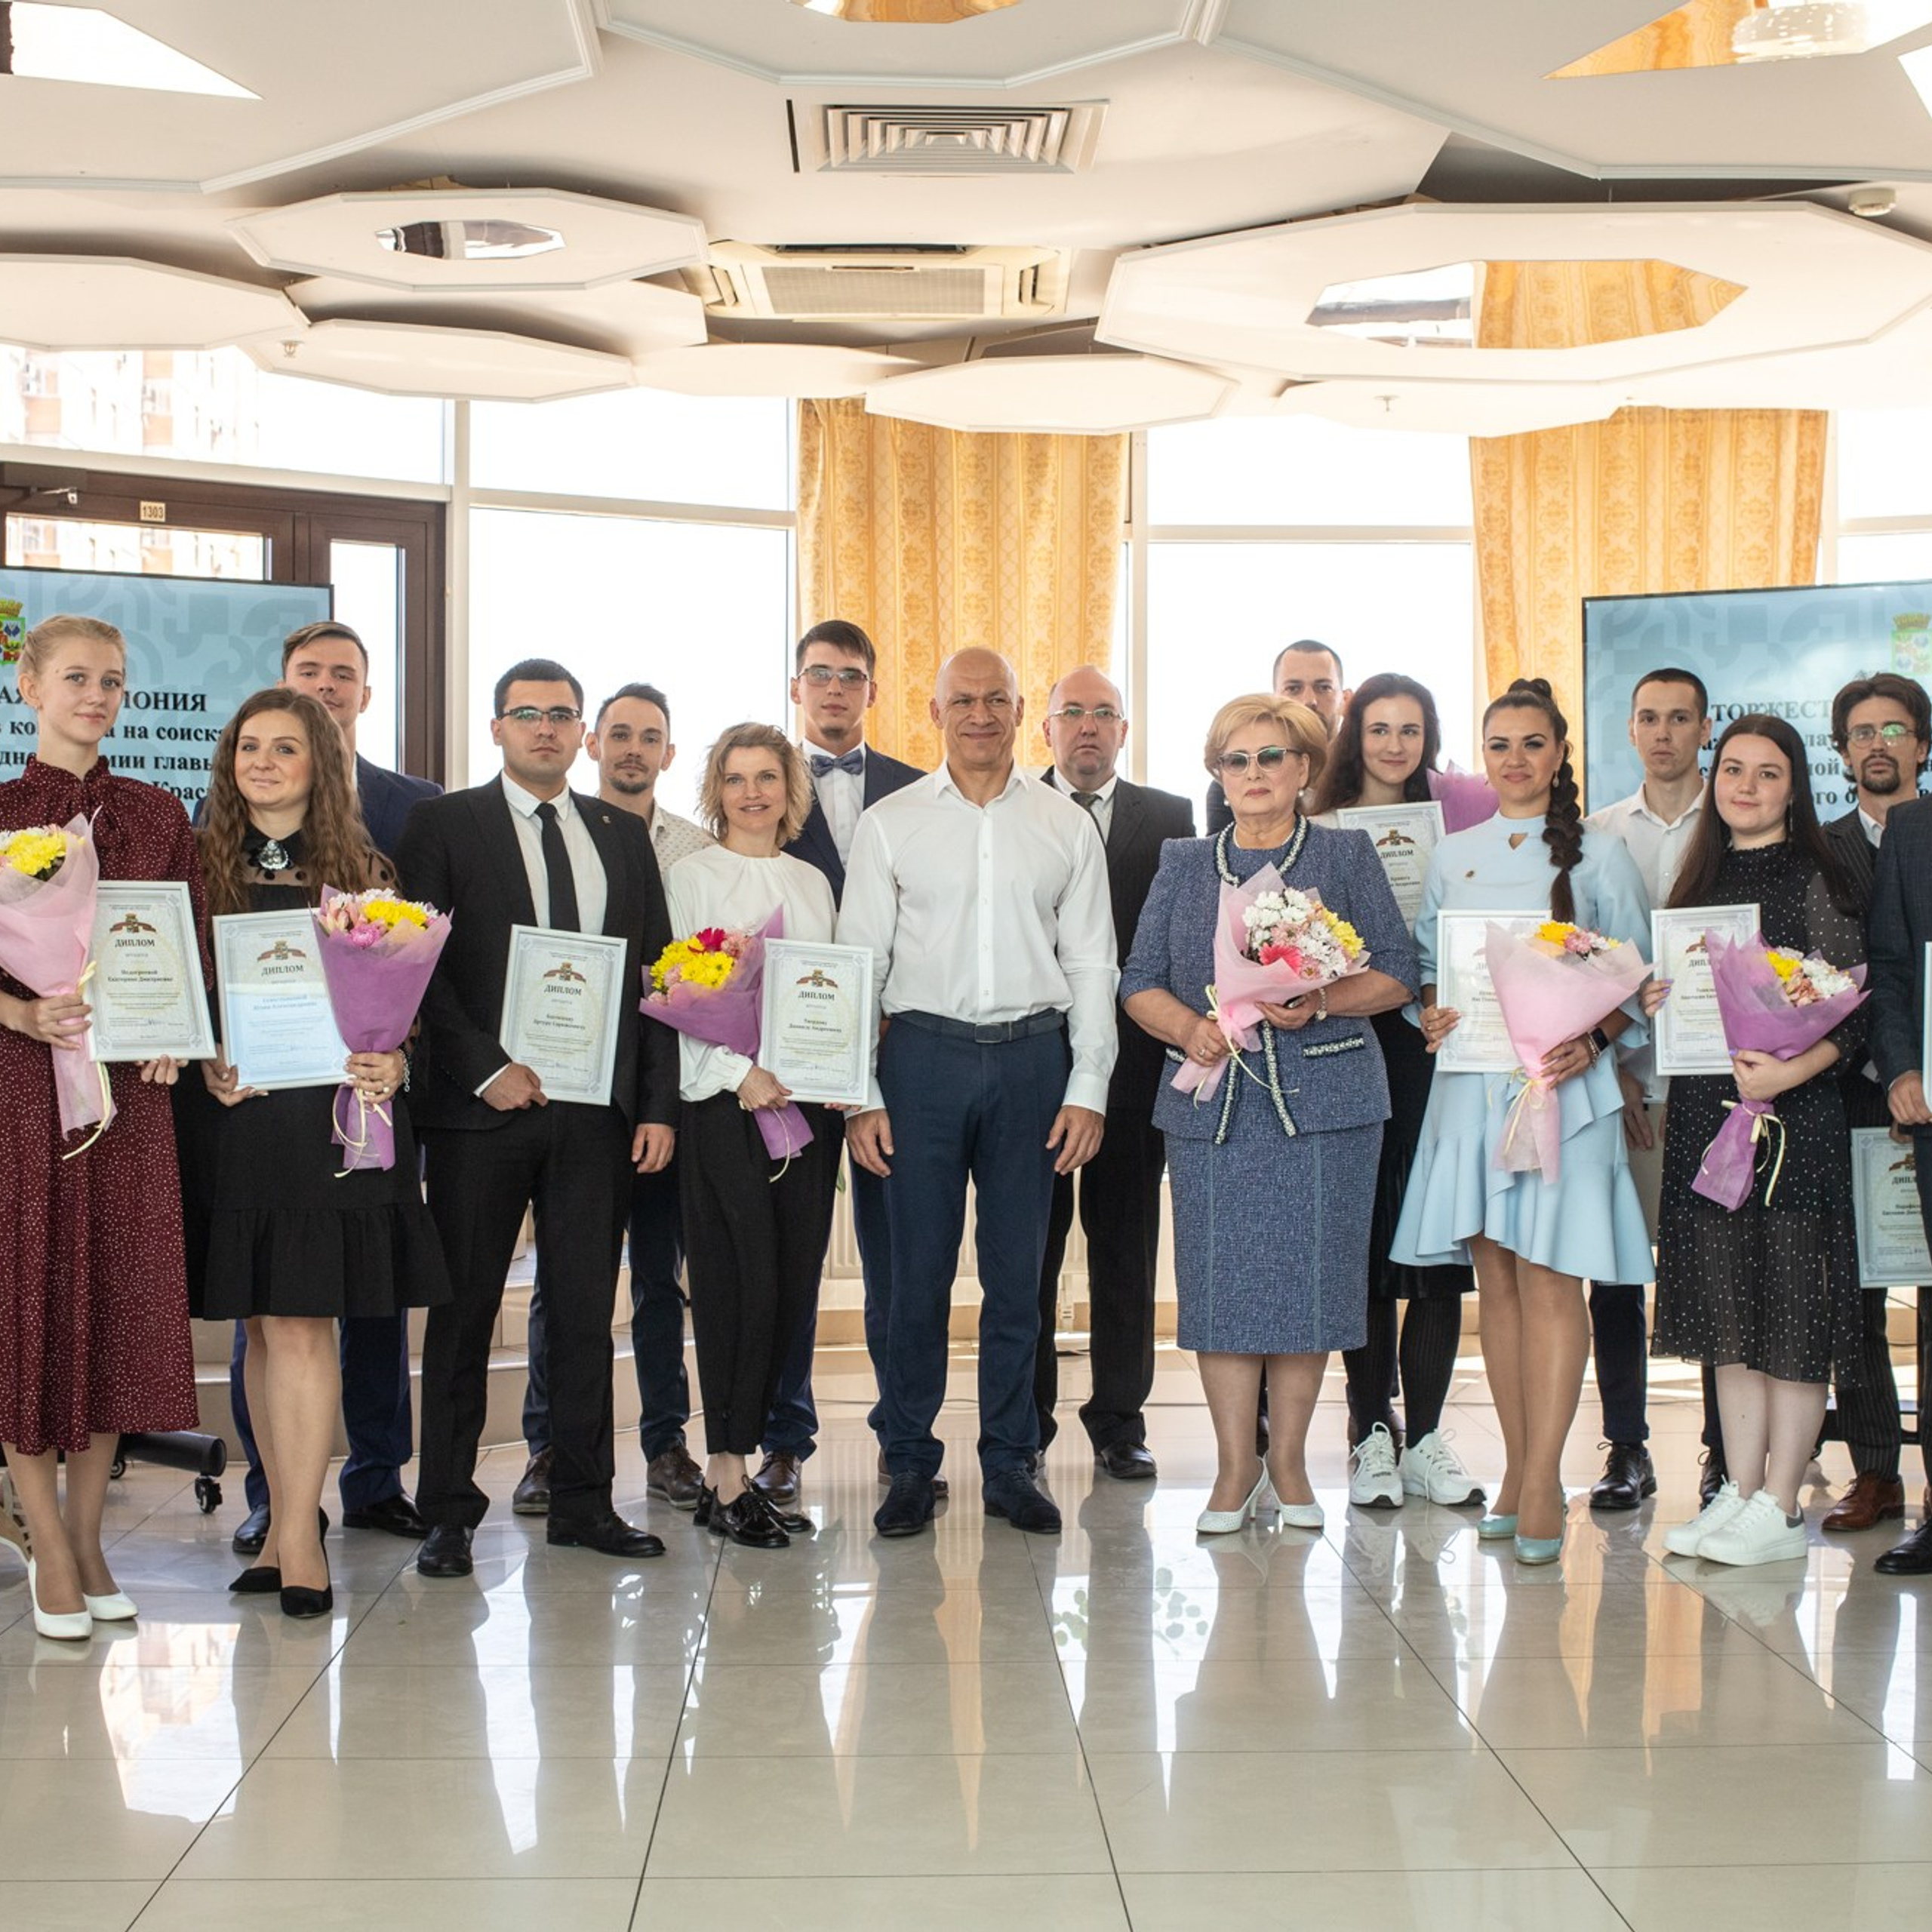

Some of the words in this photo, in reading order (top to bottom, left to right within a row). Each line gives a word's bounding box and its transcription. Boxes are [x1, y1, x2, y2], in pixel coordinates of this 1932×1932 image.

[143, 506, 164, 518] 1303
[1711, 701, 1832, 721] ТОРЖЕСТ
[124, 725, 149, 739] на
[155, 726, 223, 741] соиск
[1380, 849, 1414, 859] ДИПЛОМ
[115, 939, 155, 947] ДИПЛОМ
[261, 964, 305, 977] ДИПЛОМ
[543, 985, 582, 996] ДИПЛОМ
[798, 991, 835, 1001] ДИПЛОМ
